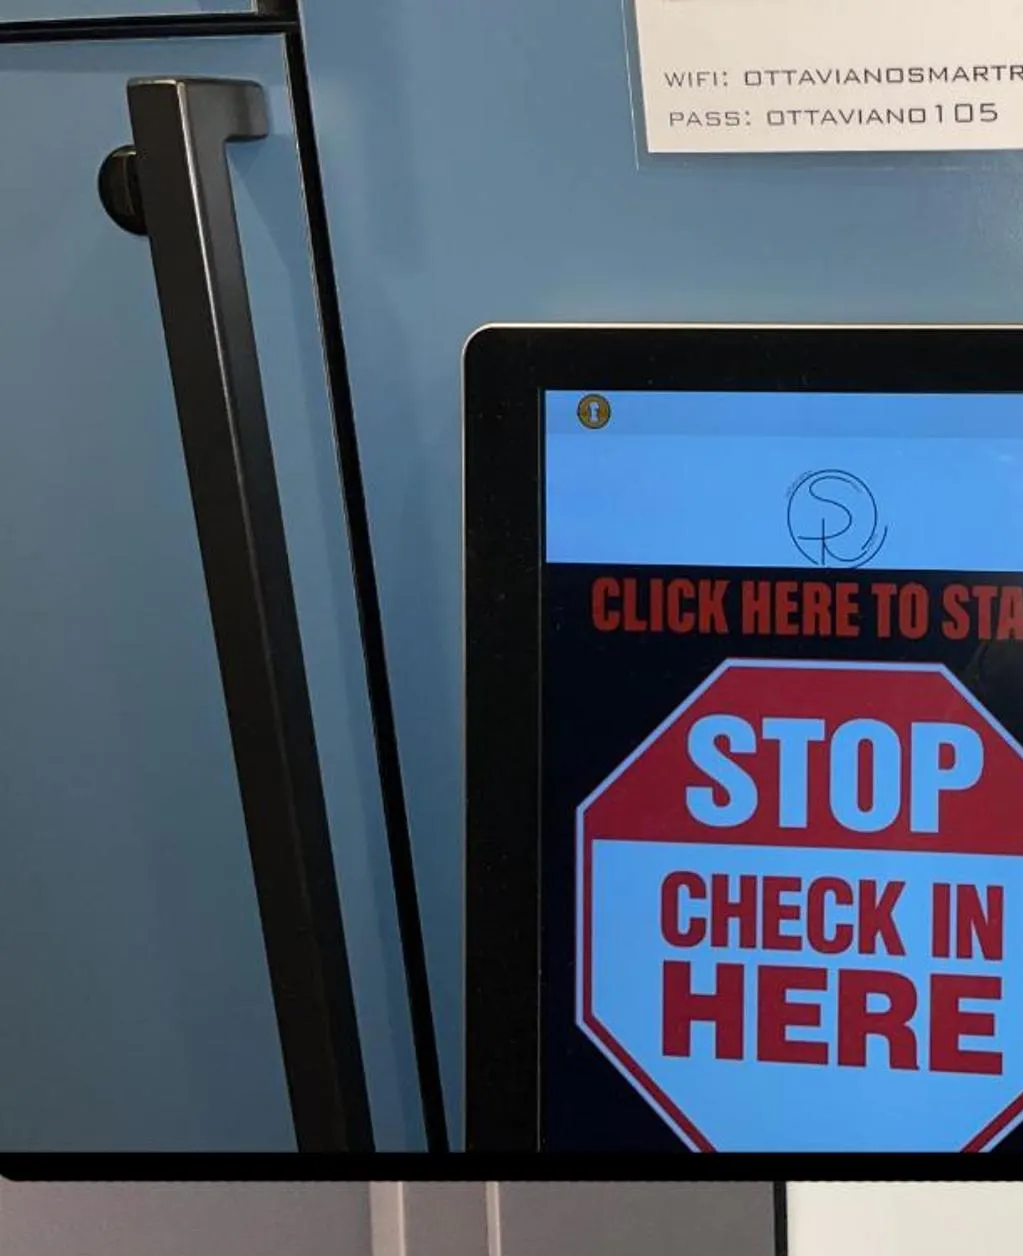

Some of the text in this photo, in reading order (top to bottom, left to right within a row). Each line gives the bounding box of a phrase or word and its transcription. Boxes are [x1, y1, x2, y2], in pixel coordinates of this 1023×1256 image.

[664, 70, 729, 90] WIFI:
[669, 102, 999, 128] PASS: OTTAVIANO105
[591, 576, 730, 635] CLICK
[741, 579, 860, 639] HERE
[872, 583, 929, 641] TO
[685, 713, 985, 834] STOP
[660, 870, 1004, 961] CHECK IN
[661, 959, 1004, 1076] HERE
